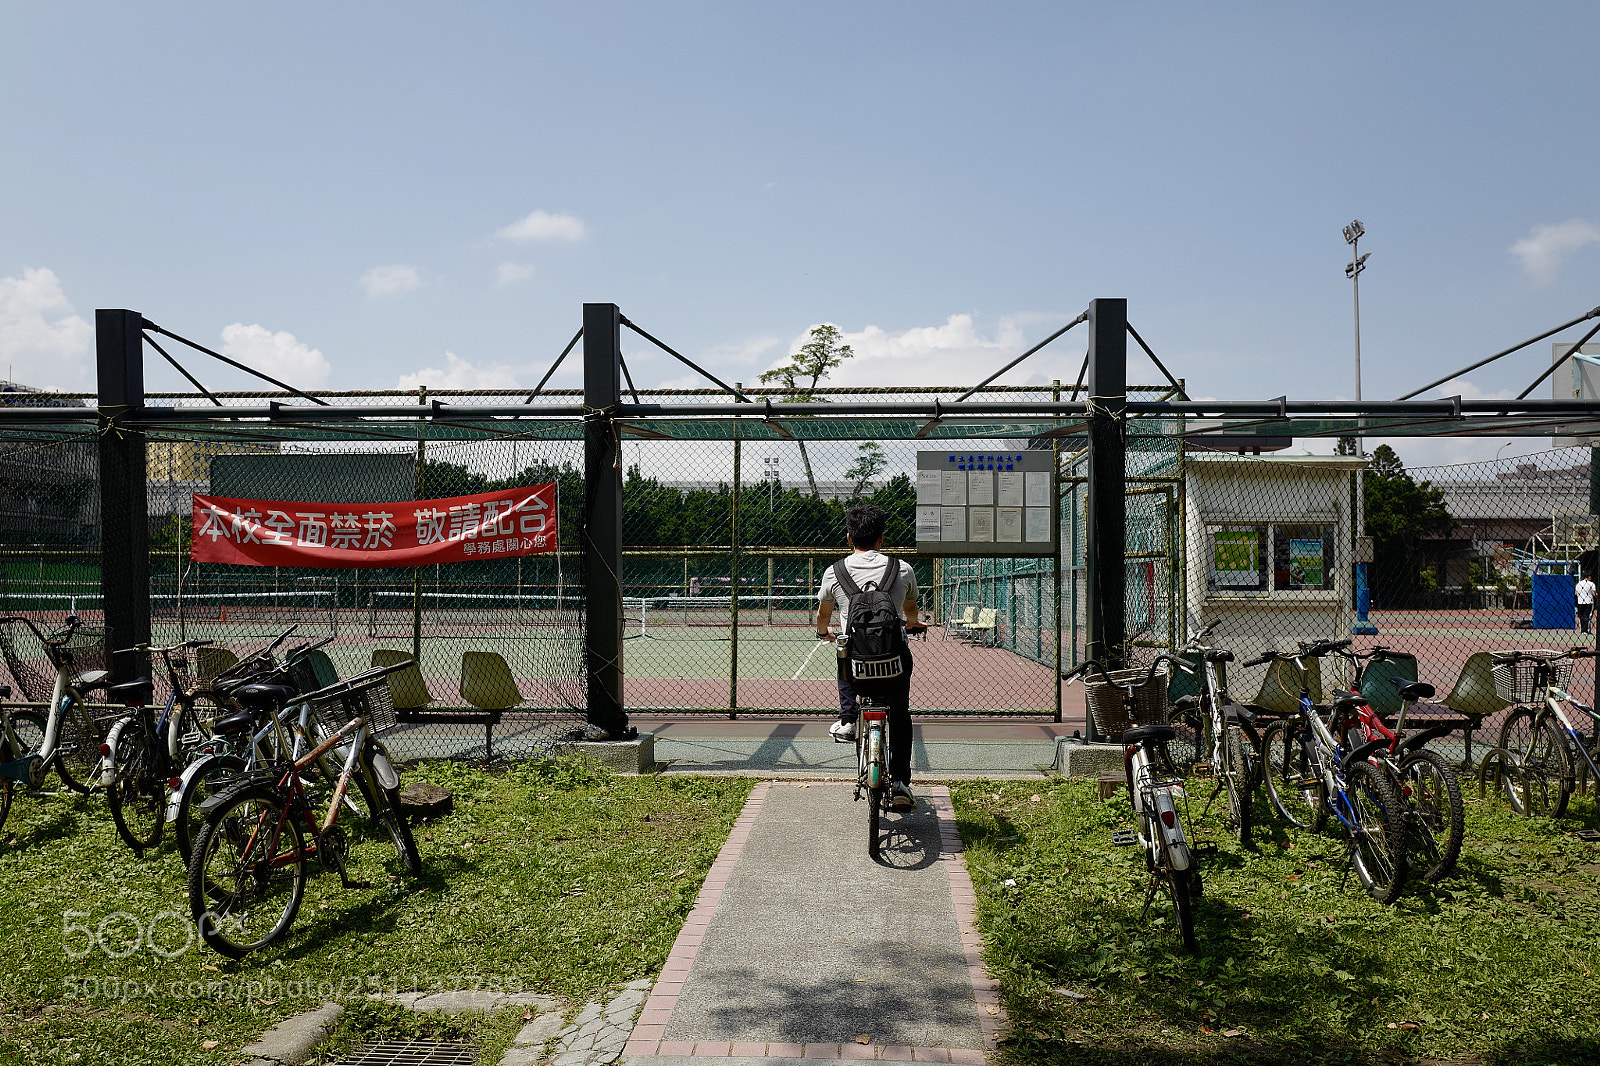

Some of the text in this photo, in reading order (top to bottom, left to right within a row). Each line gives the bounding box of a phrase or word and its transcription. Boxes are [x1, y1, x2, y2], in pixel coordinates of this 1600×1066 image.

[199, 495, 549, 549] 本校全面禁菸 敬請配合
[463, 534, 547, 556] 學務處關心您
[855, 658, 902, 678] PUMA
